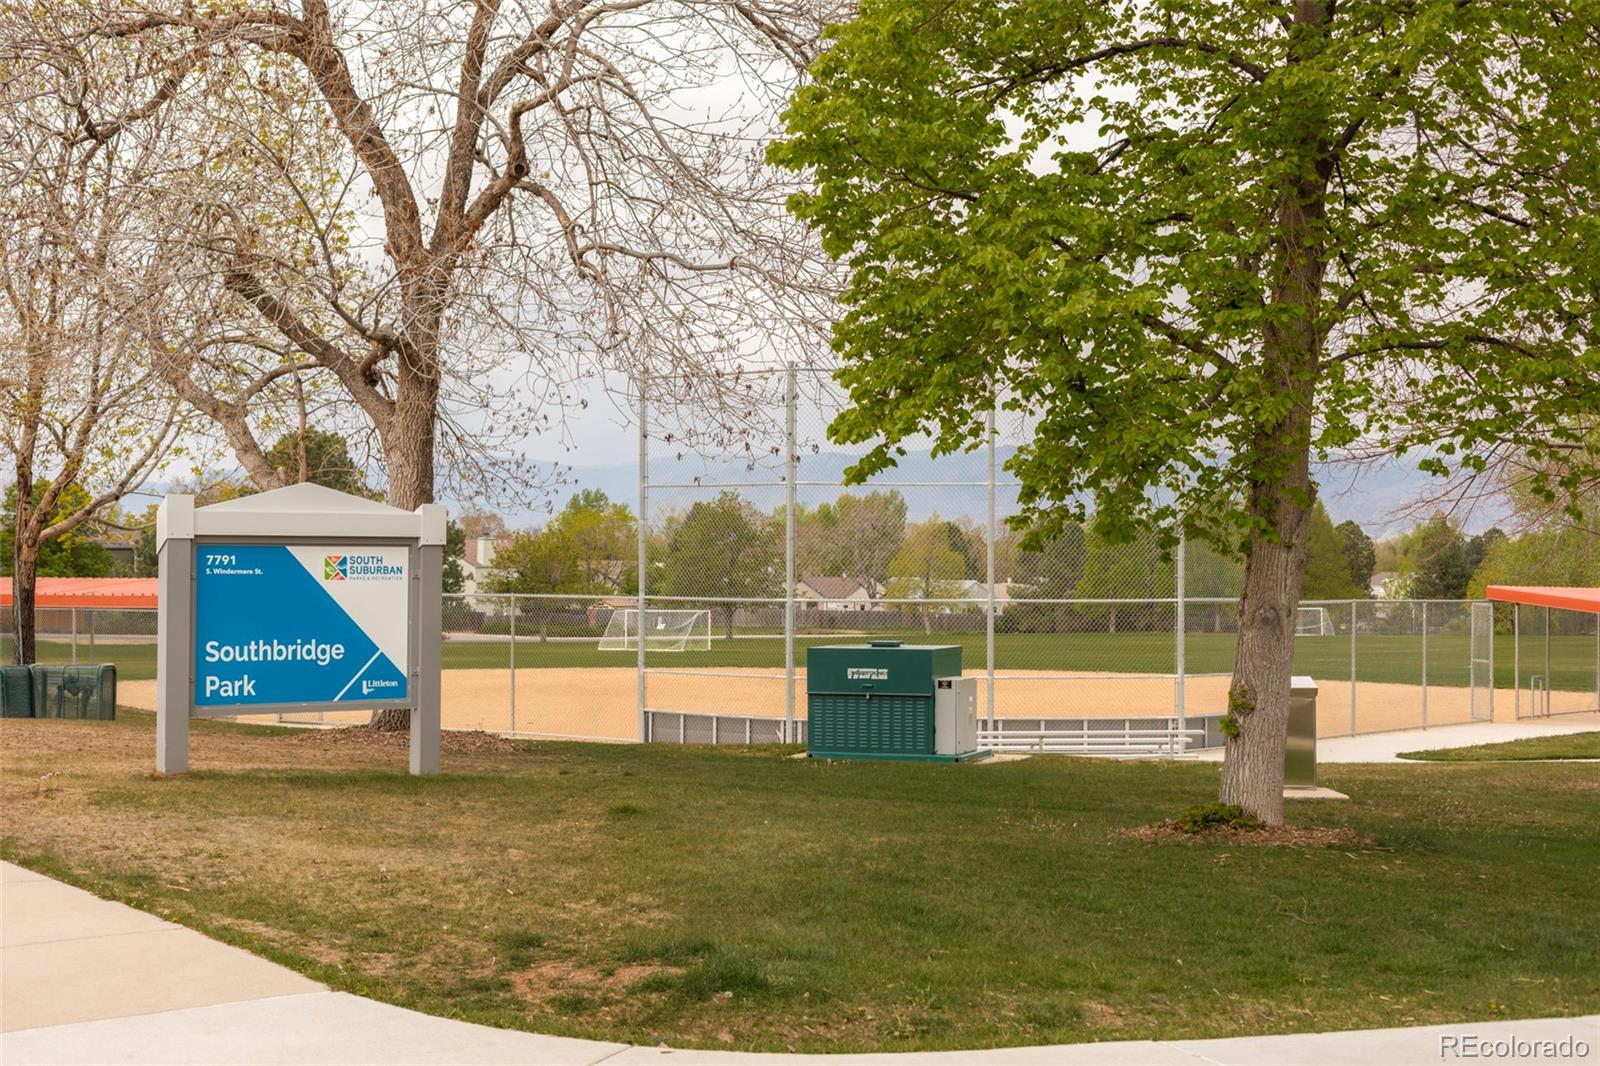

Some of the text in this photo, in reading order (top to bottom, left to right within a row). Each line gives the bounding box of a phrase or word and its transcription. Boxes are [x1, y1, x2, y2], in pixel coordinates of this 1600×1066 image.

[206, 555, 236, 565] 7791
[349, 555, 383, 565] SOUTH
[349, 566, 403, 575] SUBURBAN
[205, 639, 345, 666] Southbridge
[205, 675, 256, 697] Park
[367, 679, 399, 688] Littleton
